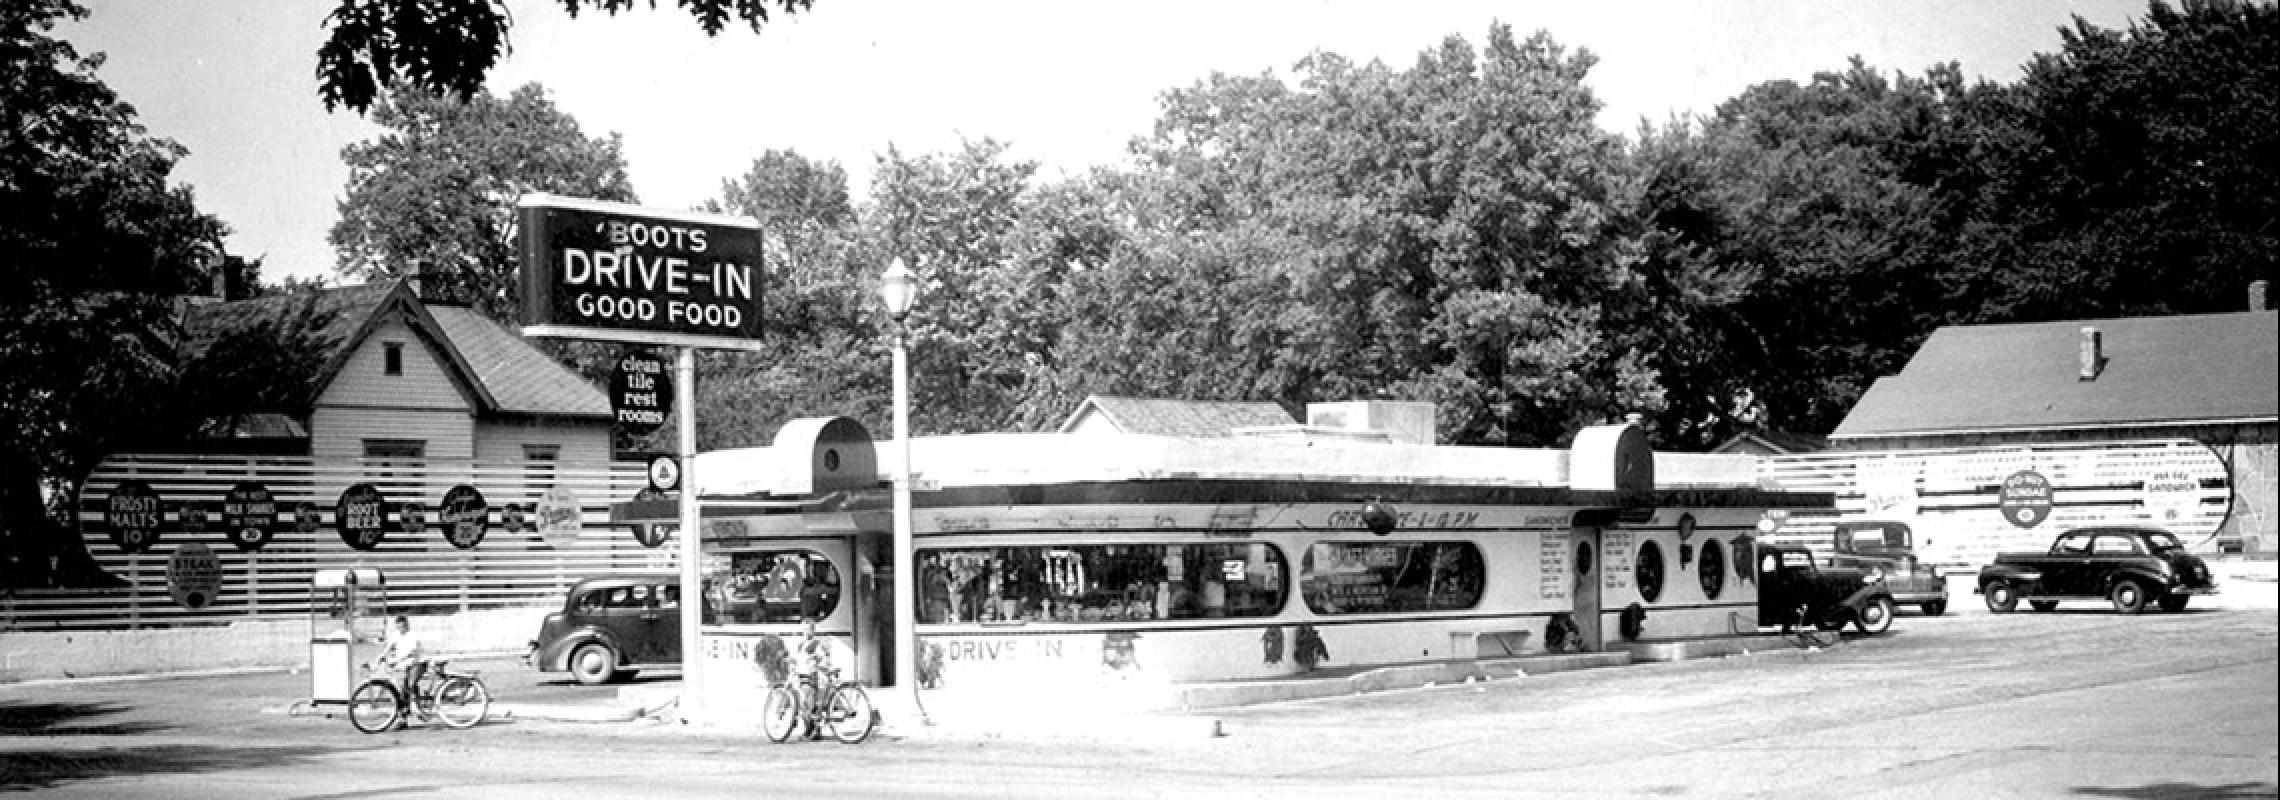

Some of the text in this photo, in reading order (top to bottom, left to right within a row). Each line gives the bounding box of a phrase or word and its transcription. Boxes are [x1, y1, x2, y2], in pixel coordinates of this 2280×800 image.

[564, 248, 751, 299] DRIVE-IN
[576, 293, 741, 327] GOOD FOOD
[621, 355, 661, 374] clean
[628, 373, 655, 389] tile
[624, 391, 657, 406] rest
[619, 408, 663, 423] rooms
[110, 496, 158, 512] FROSTY
[347, 501, 380, 515] ROOT
[110, 513, 159, 529] MALTS
[347, 514, 381, 529] BEER
[175, 557, 214, 570] STEAK
